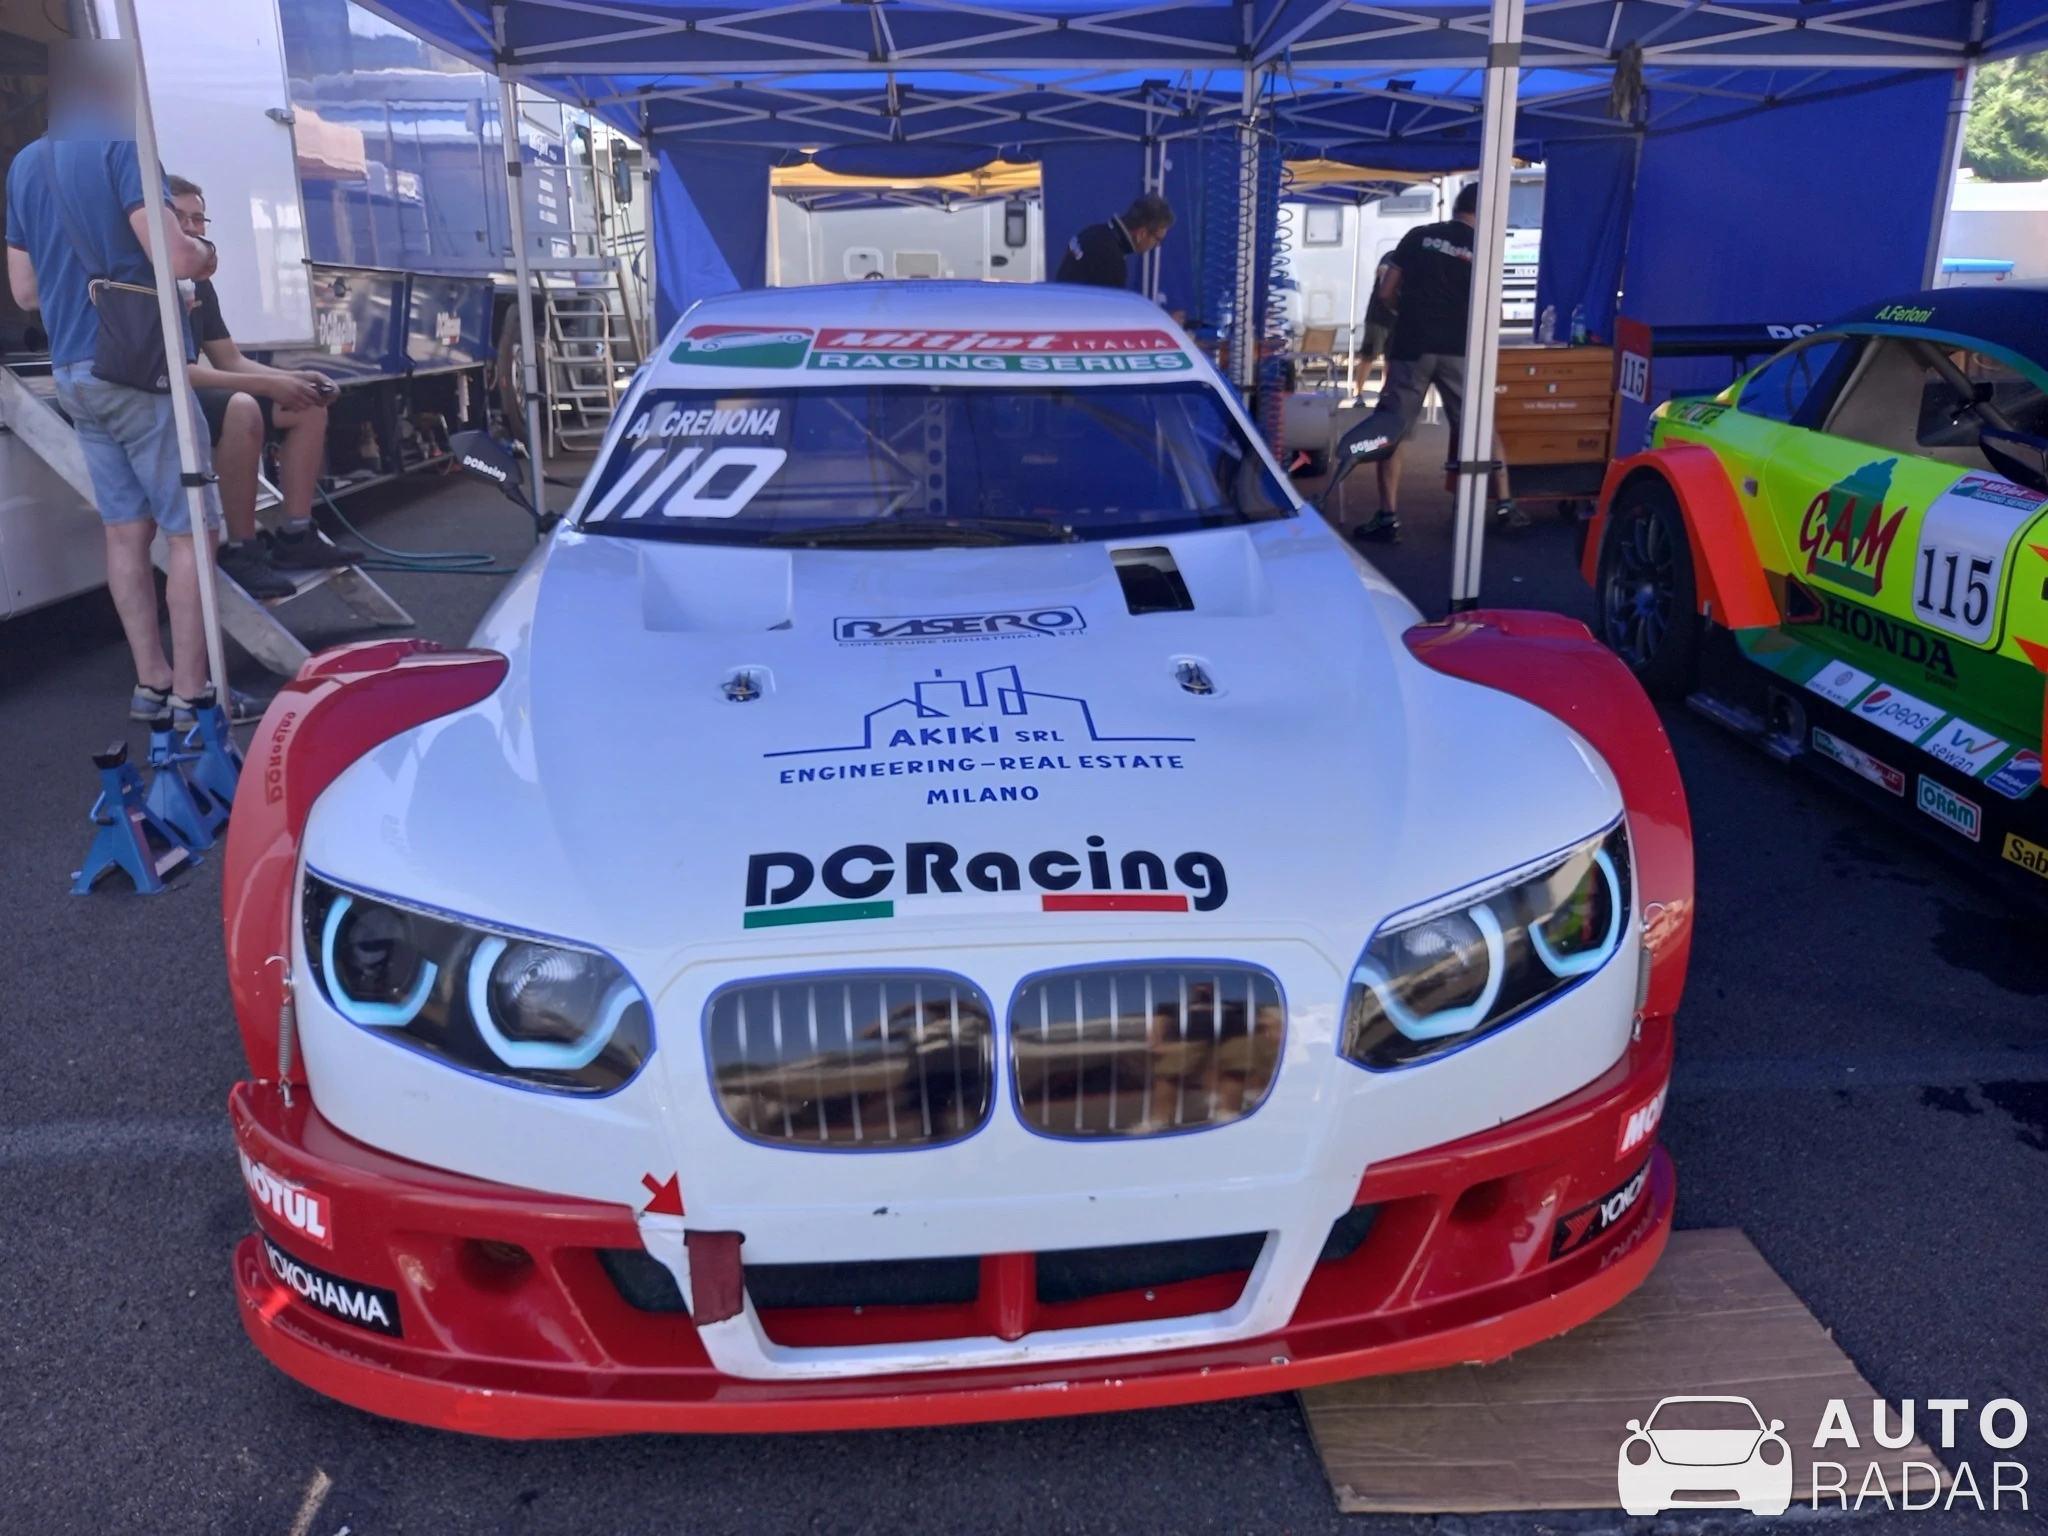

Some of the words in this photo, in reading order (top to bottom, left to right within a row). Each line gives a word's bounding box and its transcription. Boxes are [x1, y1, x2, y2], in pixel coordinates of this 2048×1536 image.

[828, 330, 1064, 351] Mitjet
[1073, 339, 1168, 350] ITALIA
[818, 353, 1006, 370] RACING
[1020, 354, 1184, 371] SERIES
[1621, 357, 1646, 397] 115
[659, 408, 780, 437] CREMONA
[584, 447, 788, 524] 110
[1799, 490, 1909, 597] GAM
[1917, 548, 1993, 627] 115
[843, 611, 1074, 638] RASERO
[1827, 597, 1958, 679] HONDA
[1879, 702, 1938, 732] pepsi
[889, 726, 999, 747] AKIKI
[1015, 730, 1065, 743] SRL
[1079, 755, 1184, 769] ESTATE
[1928, 743, 1974, 772] sewan
[927, 785, 1039, 805] MILANO
[1923, 786, 1974, 829] ORAM
[745, 835, 1229, 912] DCRacing
[264, 1240, 390, 1327] YOKOHAMA
